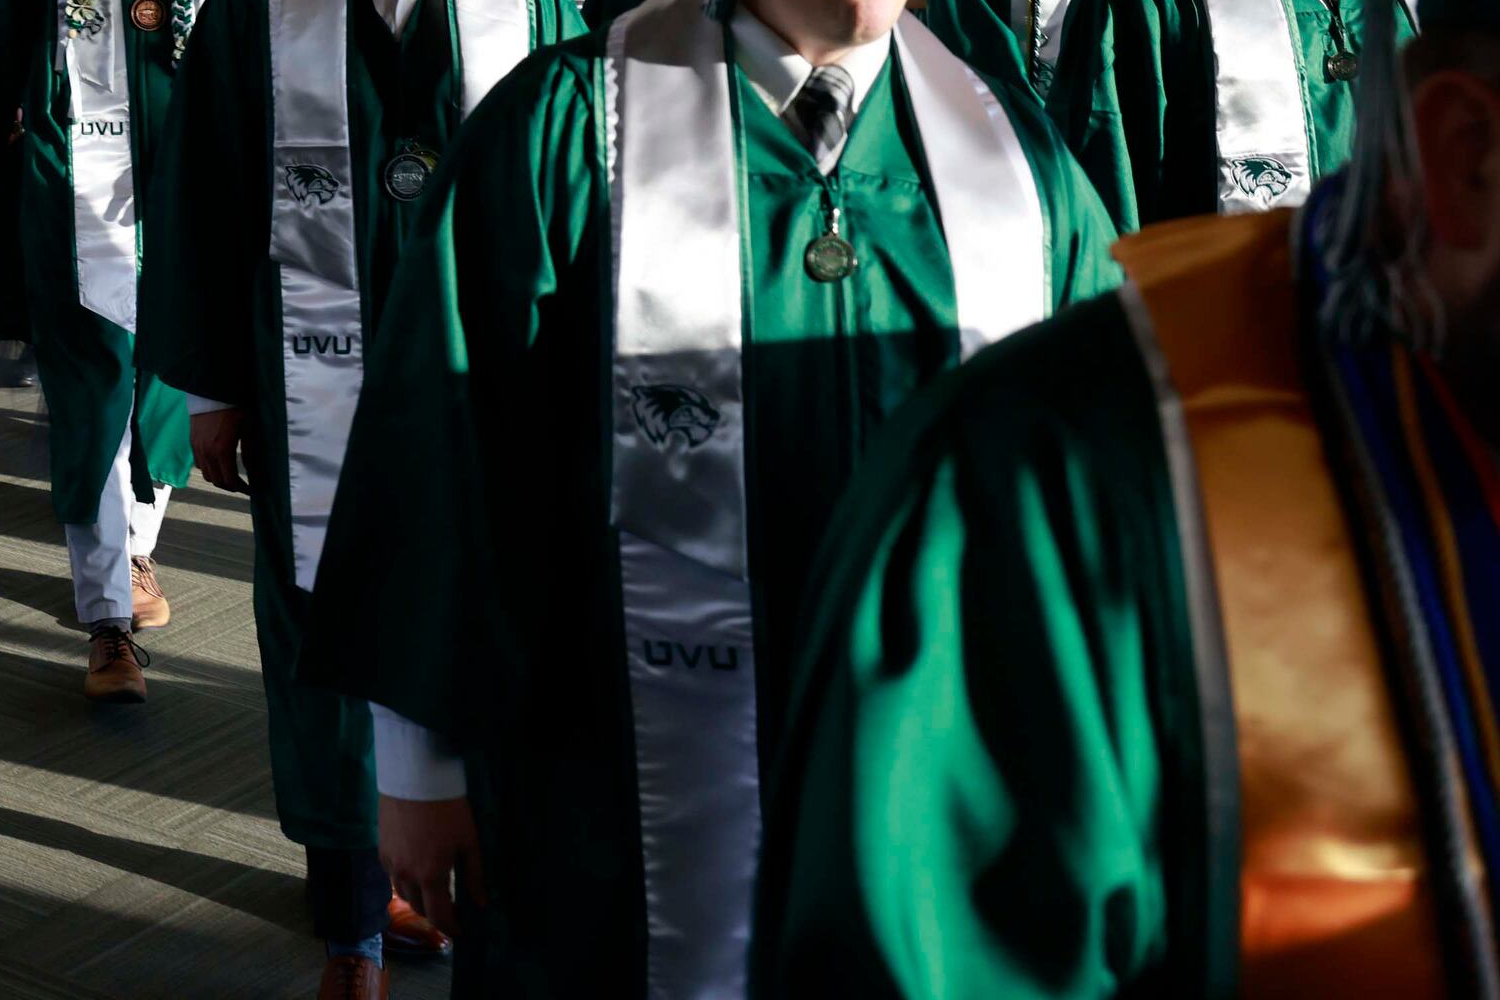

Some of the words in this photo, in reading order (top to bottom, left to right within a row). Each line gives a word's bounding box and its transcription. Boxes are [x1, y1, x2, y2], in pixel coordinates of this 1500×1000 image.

[81, 121, 124, 136] UVU
[293, 336, 351, 354] UVU
[644, 640, 737, 670] UVU
